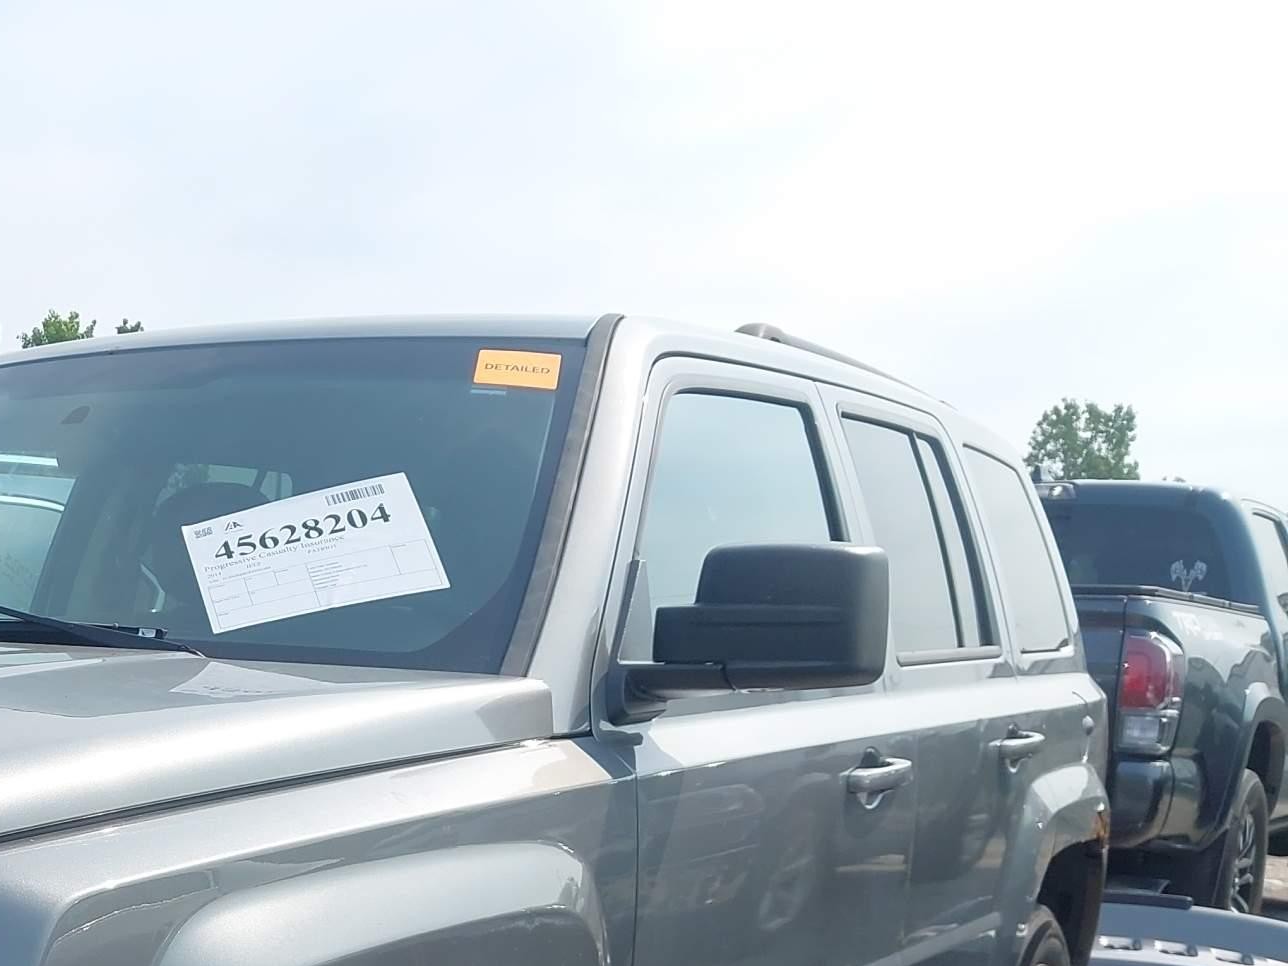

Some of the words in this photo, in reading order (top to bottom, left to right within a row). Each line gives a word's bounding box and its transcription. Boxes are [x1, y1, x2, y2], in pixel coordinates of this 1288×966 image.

[484, 363, 551, 375] DETAILED
[214, 502, 391, 560] 45628204
[204, 554, 257, 574] Progressive
[258, 544, 299, 560] Casualty
